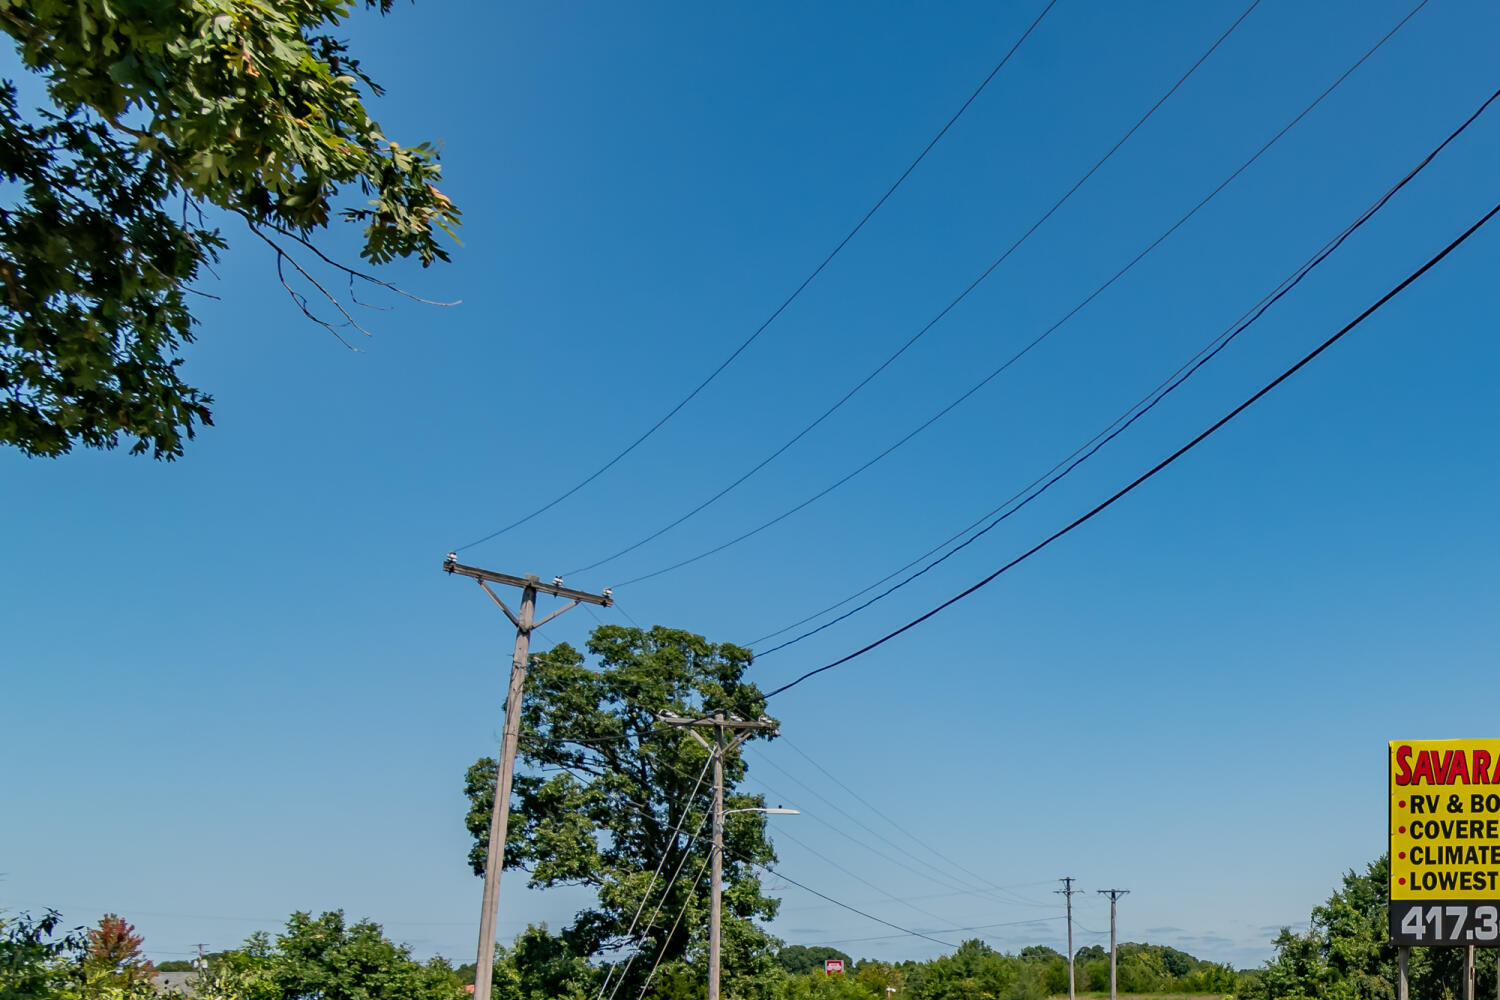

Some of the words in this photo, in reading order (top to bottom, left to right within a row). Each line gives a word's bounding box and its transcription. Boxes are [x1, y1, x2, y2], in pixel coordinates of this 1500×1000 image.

[1410, 794, 1440, 814] RV
[1446, 794, 1463, 813] &
[1410, 871, 1499, 891] LOWEST
